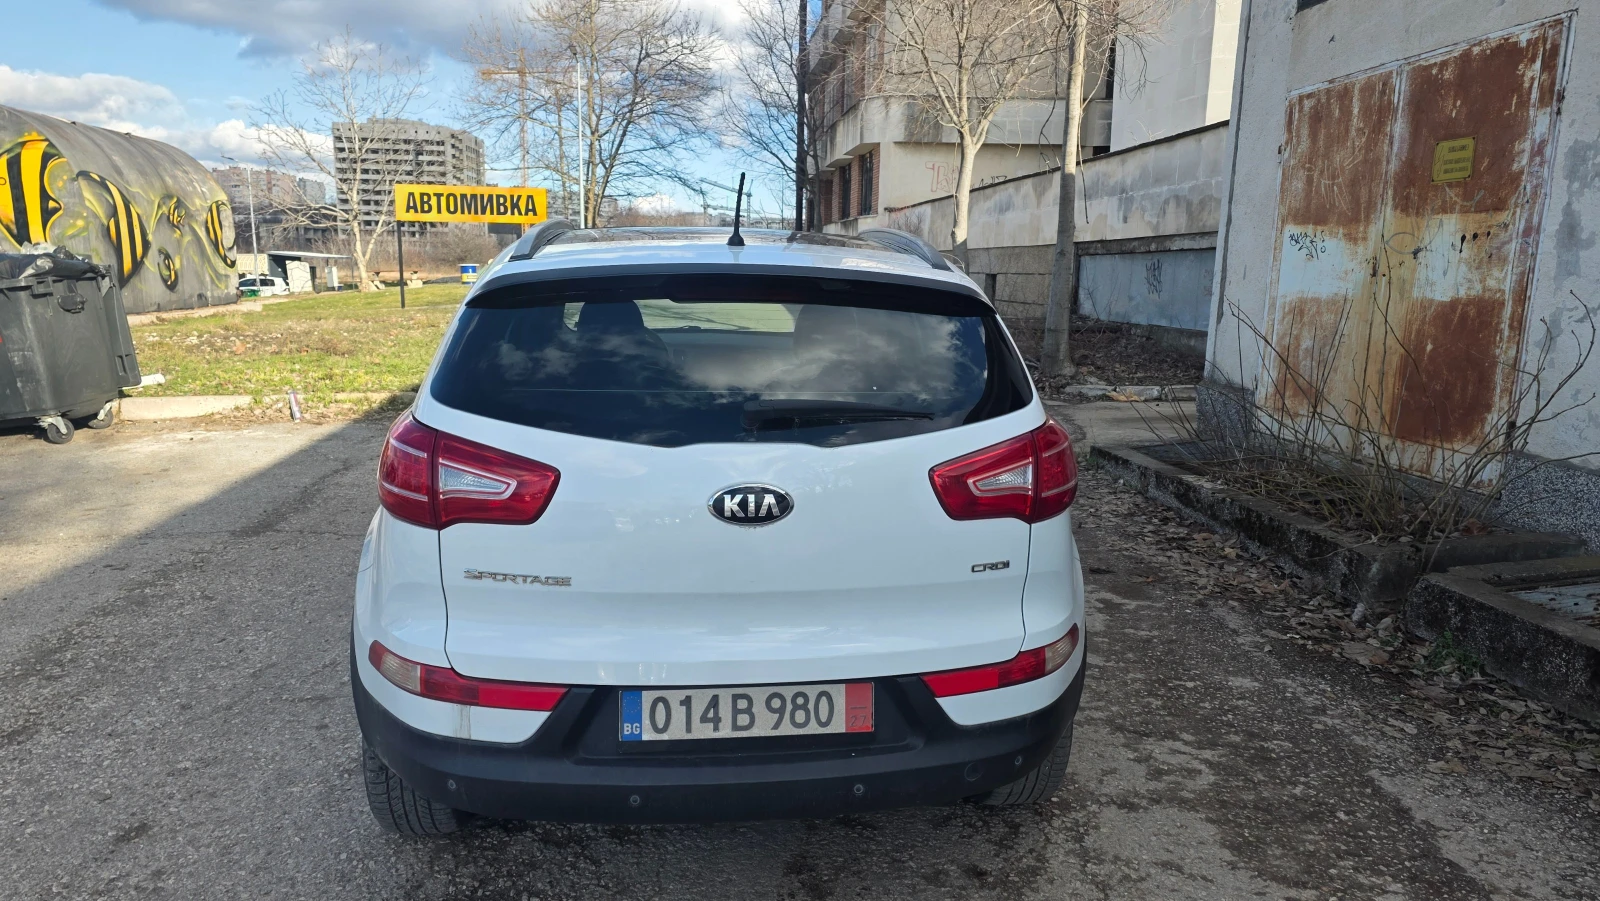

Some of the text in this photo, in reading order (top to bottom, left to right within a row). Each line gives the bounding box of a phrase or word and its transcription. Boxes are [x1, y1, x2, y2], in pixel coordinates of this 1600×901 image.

[405, 192, 538, 217] АВТОМИВКА
[723, 493, 781, 518] KIA
[463, 568, 572, 586] SPORTAGE
[623, 690, 867, 735] BG 014B980 27
